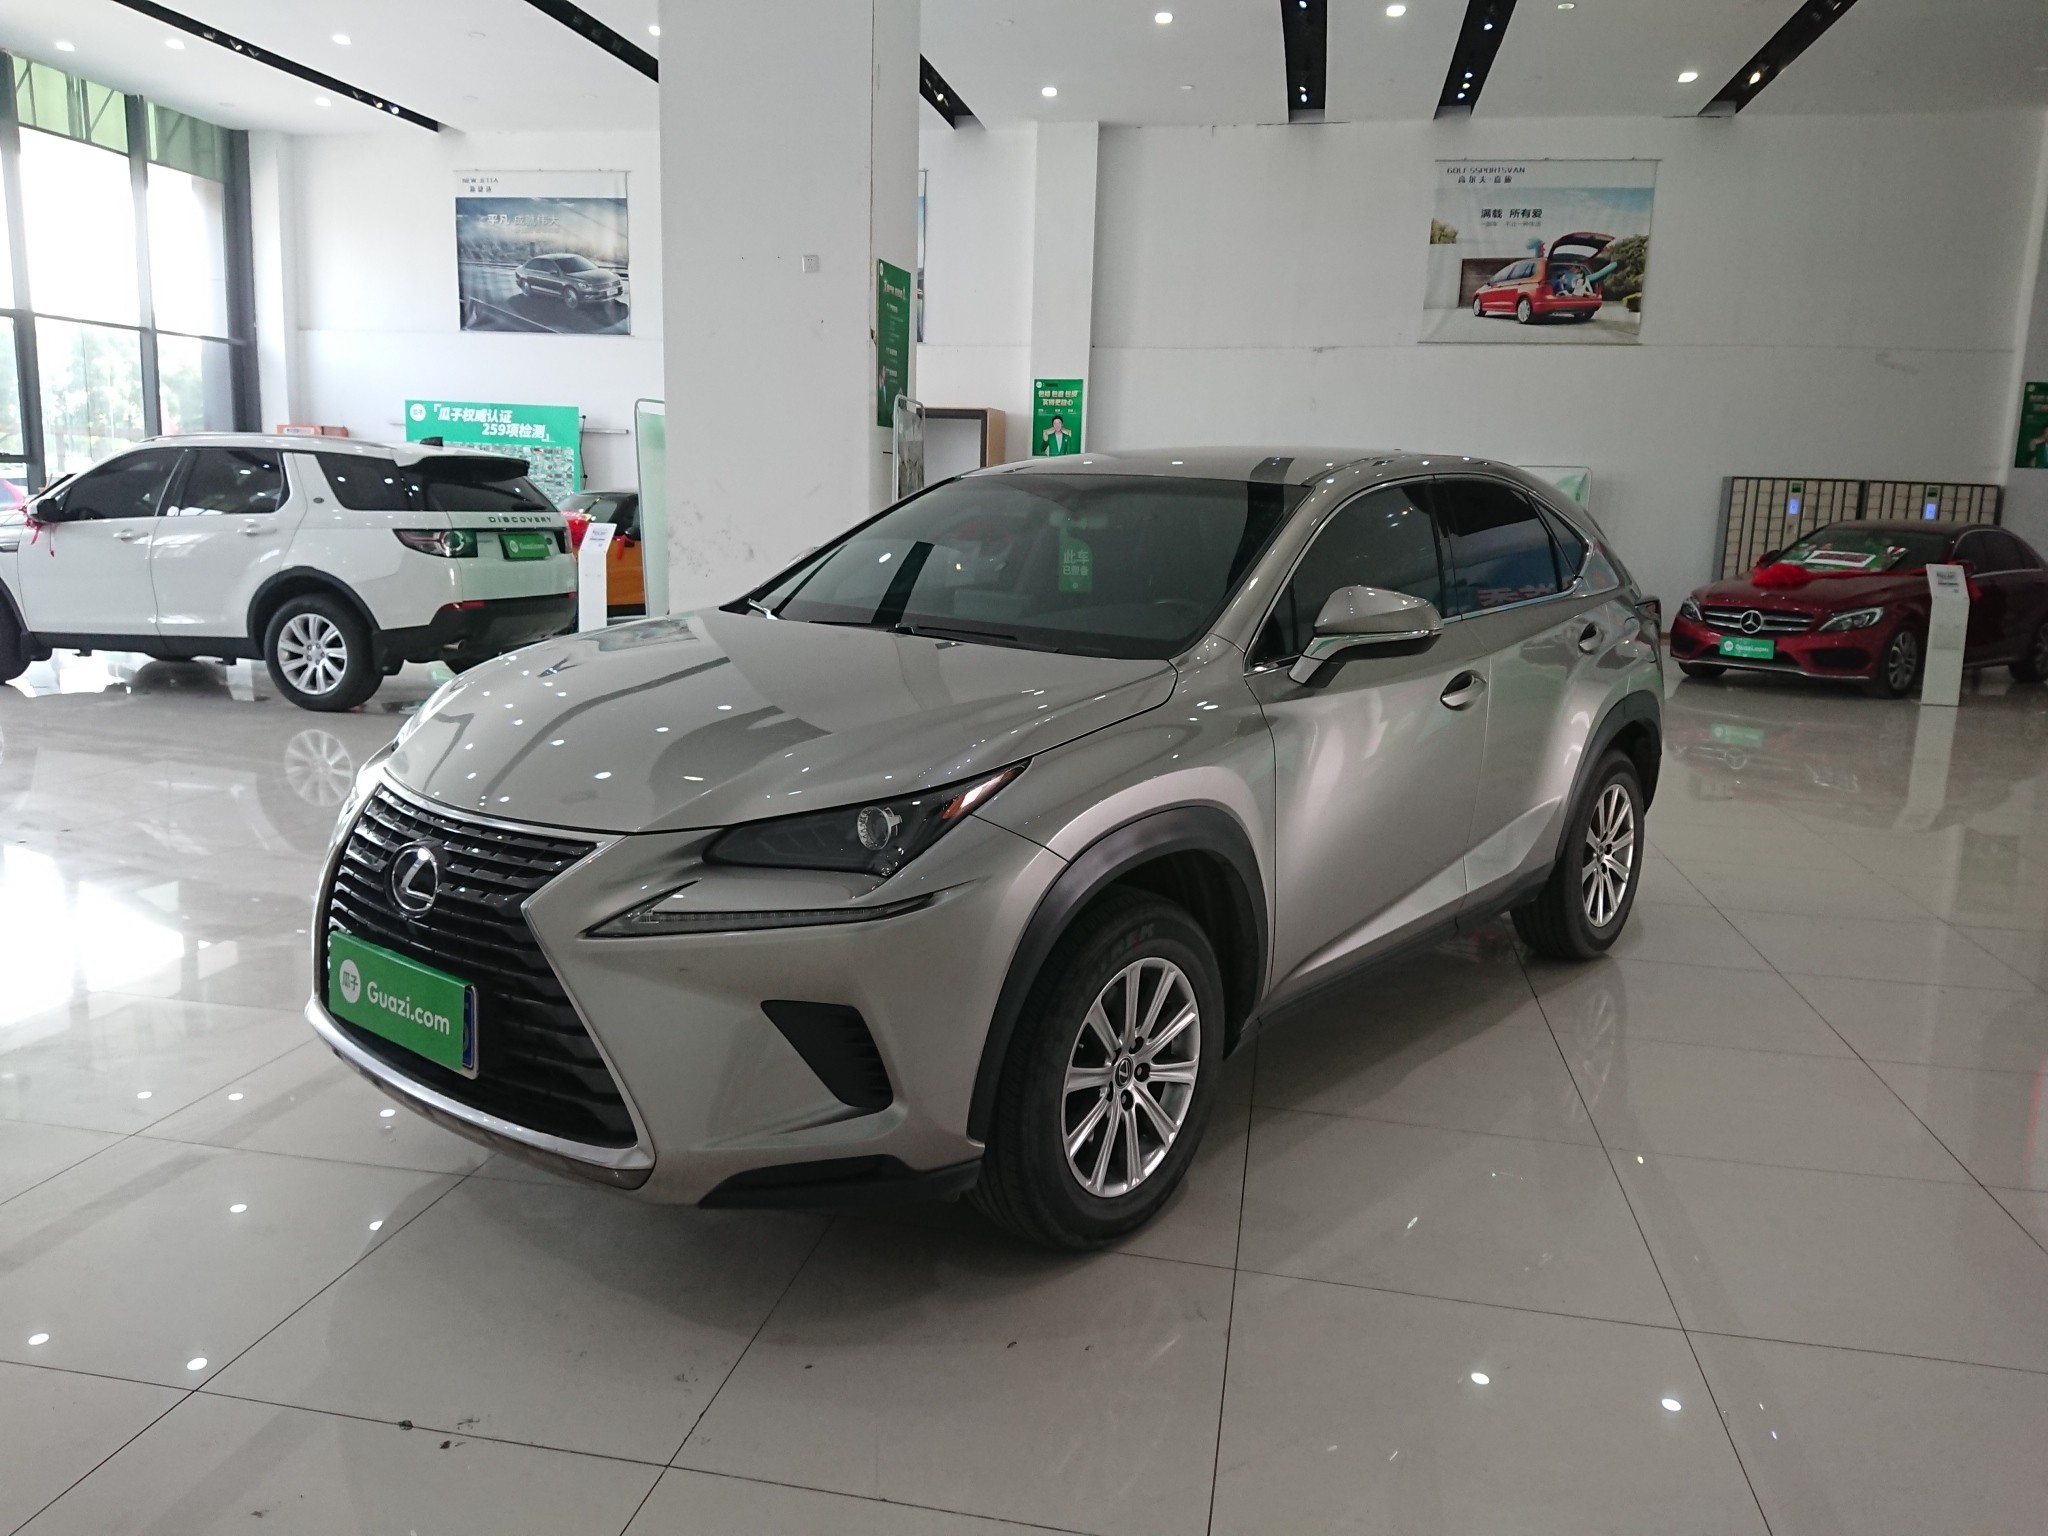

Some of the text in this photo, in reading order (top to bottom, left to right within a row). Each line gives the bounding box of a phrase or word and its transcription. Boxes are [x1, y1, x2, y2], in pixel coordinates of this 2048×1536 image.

[1509, 208, 1543, 219] 所有爱
[1063, 549, 1090, 565] 此车
[341, 971, 359, 992] 瓜子
[366, 980, 450, 1036] Guazi.com
